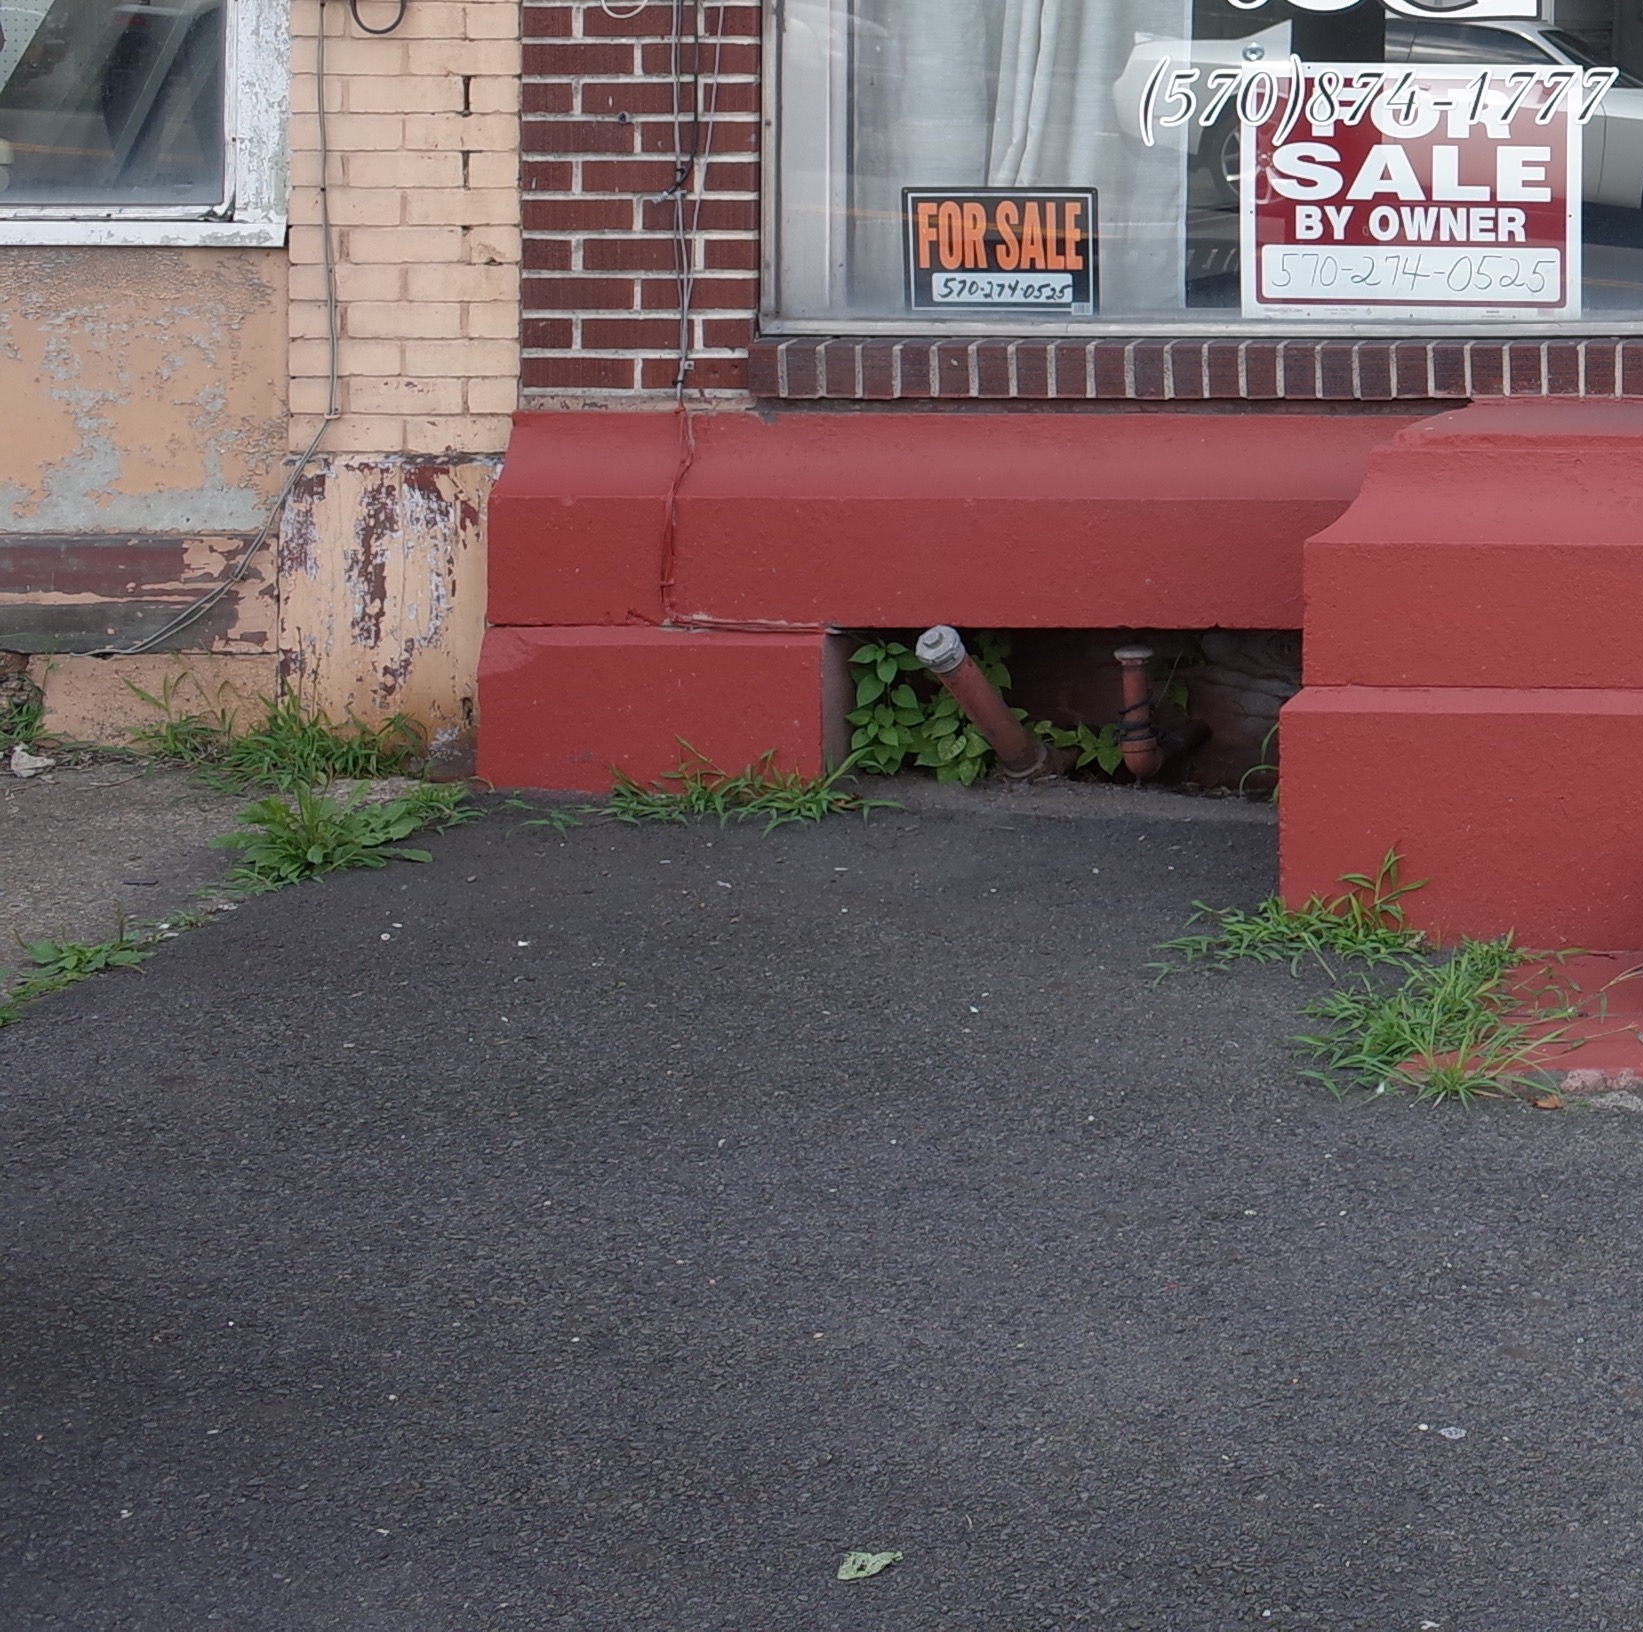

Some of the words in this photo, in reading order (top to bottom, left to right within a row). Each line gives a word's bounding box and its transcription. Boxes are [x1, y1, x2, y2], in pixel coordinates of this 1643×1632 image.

[1138, 53, 1619, 146] (570)874-1777
[1312, 86, 1512, 139] FOR
[1272, 144, 1552, 202] SALE
[916, 201, 989, 271] FOR
[995, 200, 1084, 271] SALE
[1295, 206, 1353, 242] BY
[1368, 206, 1527, 243] OWNER
[1271, 253, 1557, 293] 570-274-0525
